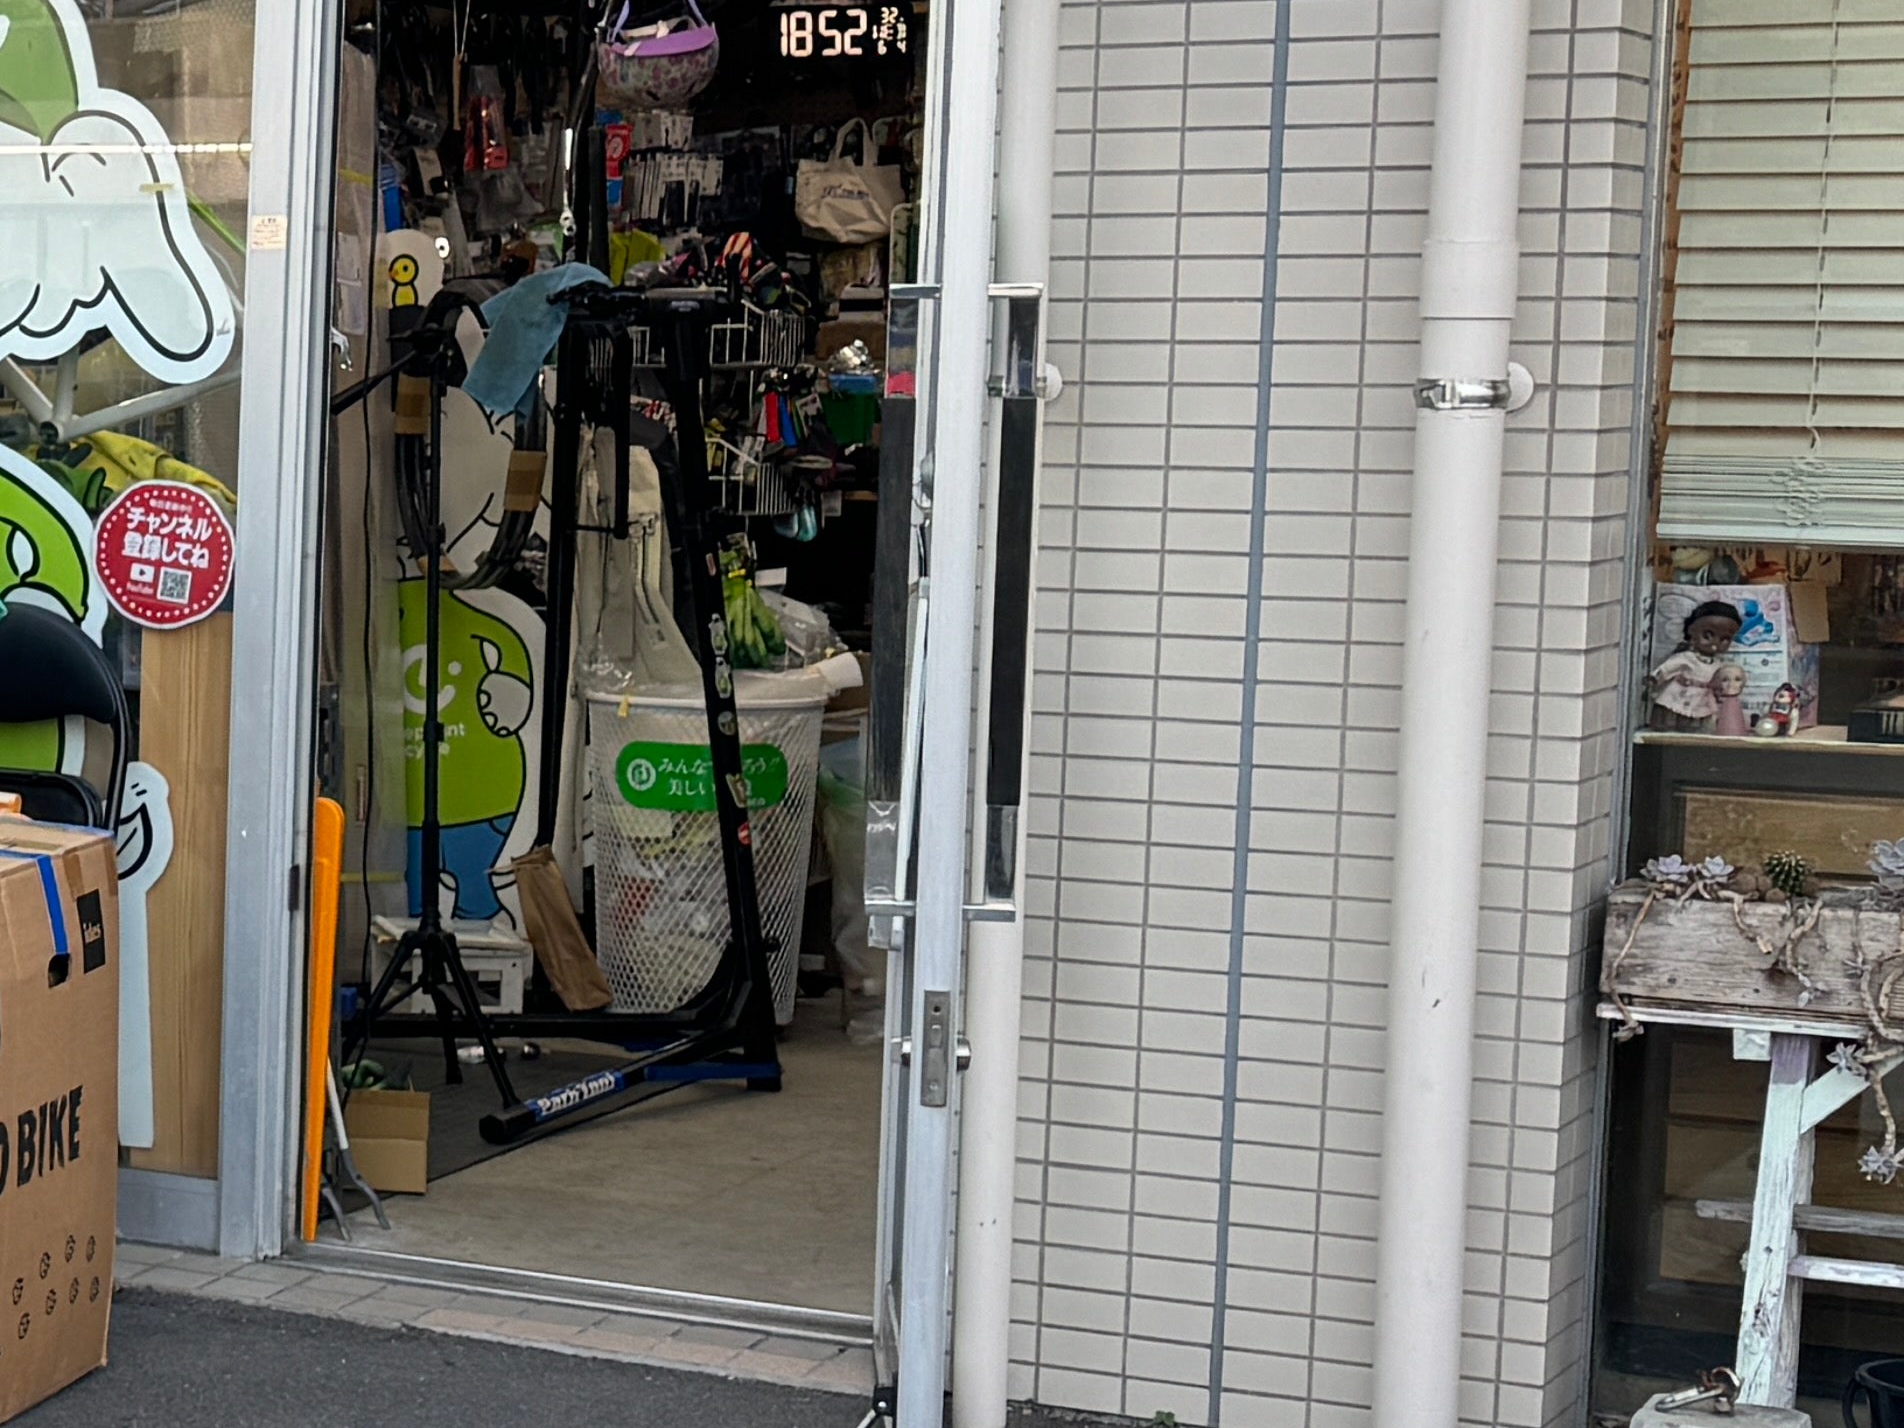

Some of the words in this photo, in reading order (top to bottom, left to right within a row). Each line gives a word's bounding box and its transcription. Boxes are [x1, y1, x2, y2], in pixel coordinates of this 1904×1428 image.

[127, 506, 213, 542] チャンネル
[122, 531, 210, 569] 登録してね
[17, 1084, 84, 1188] BIKE
